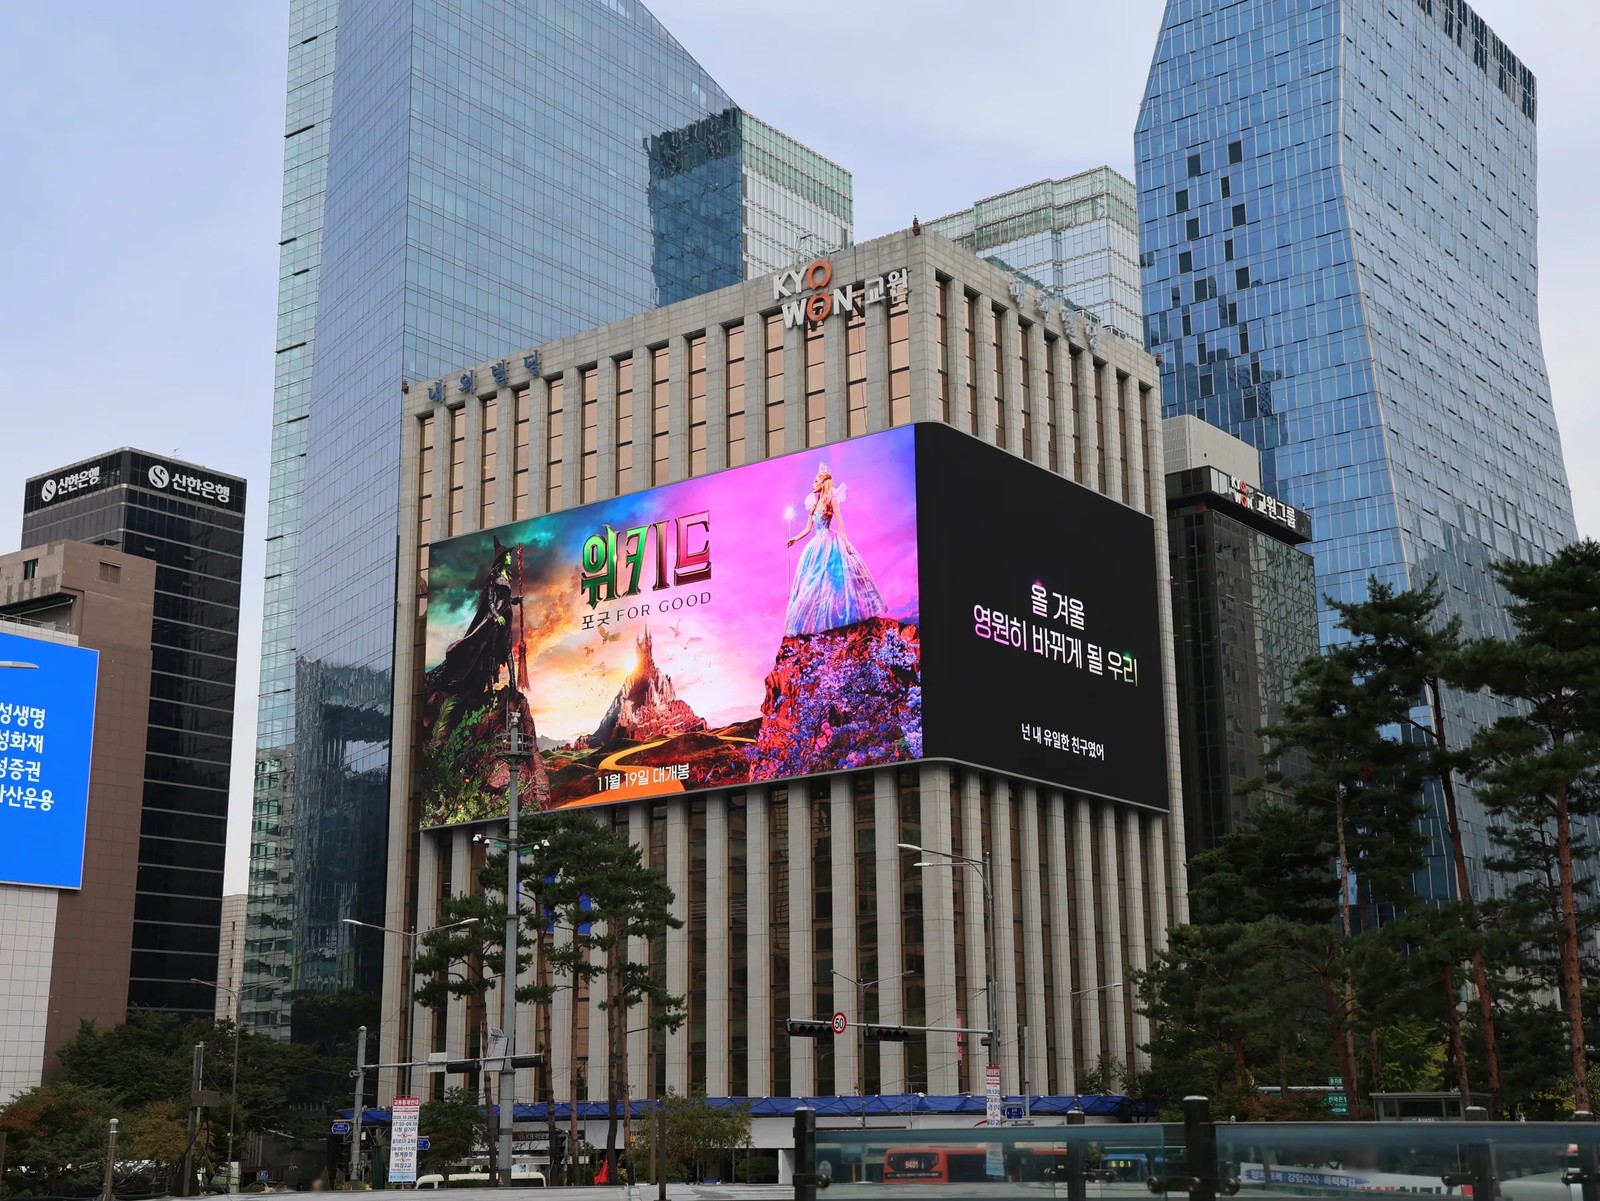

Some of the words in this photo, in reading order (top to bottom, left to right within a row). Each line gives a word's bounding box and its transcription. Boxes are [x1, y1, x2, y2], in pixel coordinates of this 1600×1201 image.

[773, 259, 832, 300] KYO
[781, 284, 853, 329] WON
[865, 268, 909, 304] 교원
[57, 466, 100, 496] 신한은행
[171, 473, 230, 503] 신한은행
[1256, 491, 1296, 529] 교원그룹
[581, 510, 712, 610] 위키드
[582, 611, 610, 631] 포굿
[616, 604, 651, 622] FOR
[658, 591, 712, 613] GOOD
[1031, 583, 1048, 618] 올
[1052, 591, 1085, 631] 겨울
[973, 604, 1027, 651] 영원히
[1032, 624, 1083, 670] 바뀌게
[1086, 643, 1103, 676] 될
[1107, 650, 1138, 687] 우리
[1021, 722, 1031, 741] 넌
[1032, 726, 1042, 745] 내
[1043, 729, 1070, 752] 유일한
[1071, 736, 1105, 761] 친구였어
[597, 773, 621, 792] 11월
[624, 769, 649, 788] 19일
[653, 763, 690, 783] 대개봉
[834, 1018, 844, 1030] 50
[904, 1160, 919, 1169] 9401
